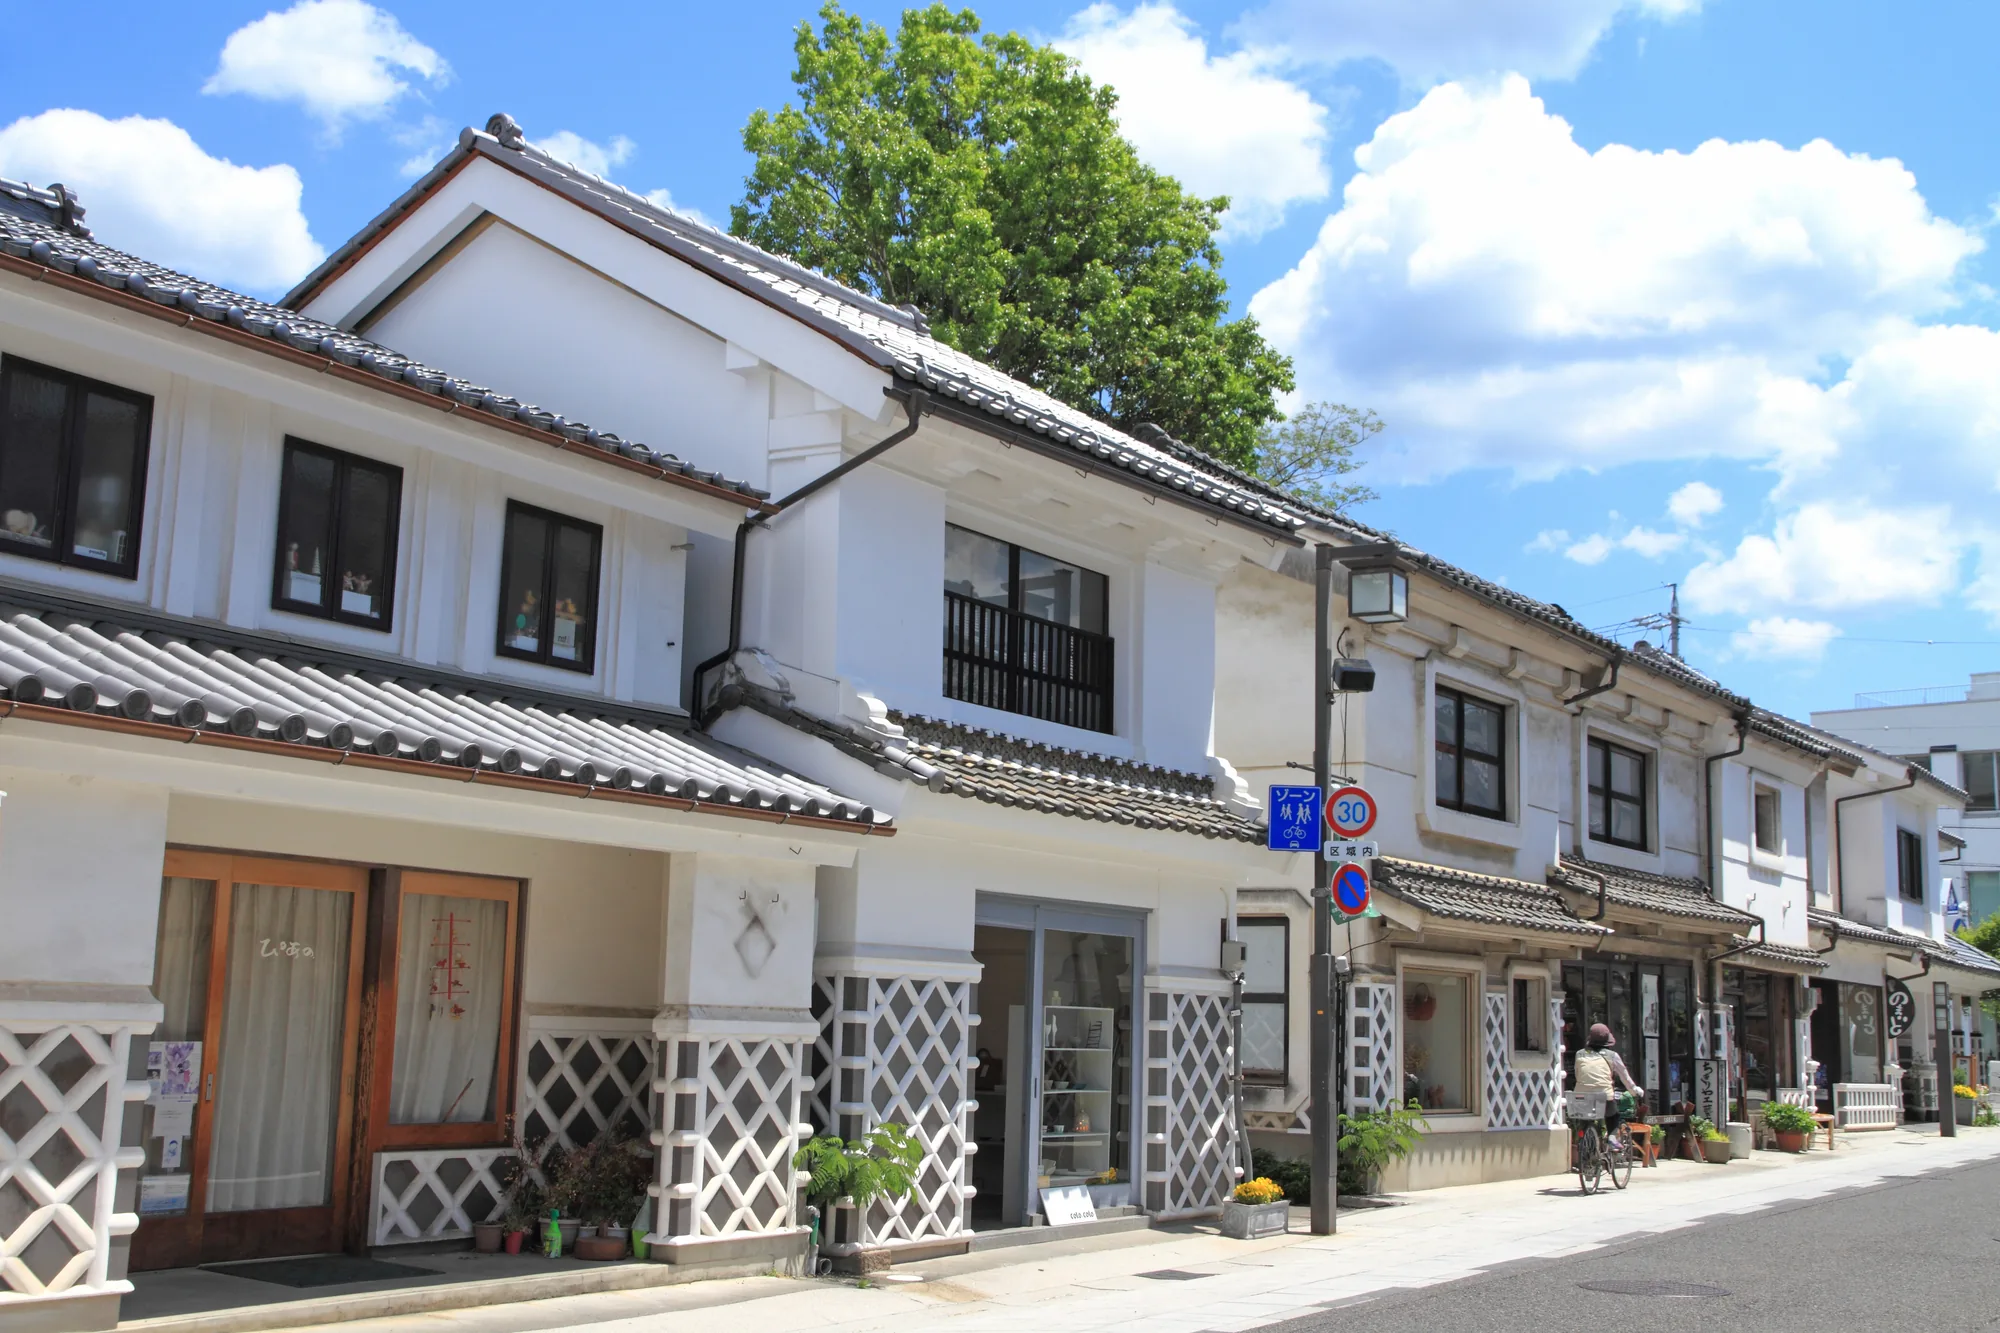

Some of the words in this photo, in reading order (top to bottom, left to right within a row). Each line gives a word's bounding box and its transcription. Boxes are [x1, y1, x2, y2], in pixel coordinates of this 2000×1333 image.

[1275, 789, 1316, 803] ゾーン
[1337, 801, 1367, 824] 30
[1330, 846, 1373, 857] 区域内
[259, 938, 315, 959] ぴあの
